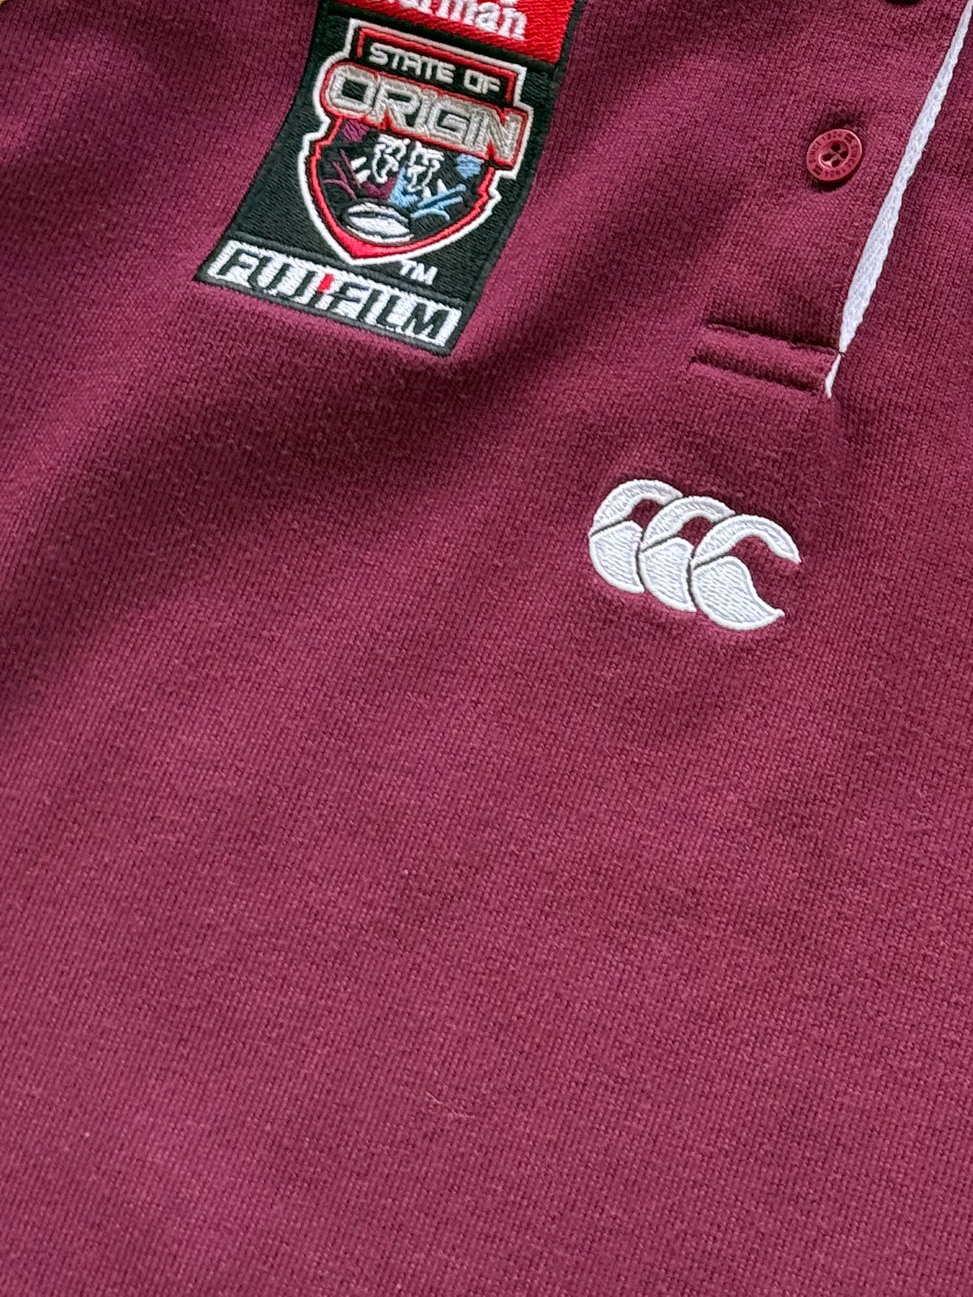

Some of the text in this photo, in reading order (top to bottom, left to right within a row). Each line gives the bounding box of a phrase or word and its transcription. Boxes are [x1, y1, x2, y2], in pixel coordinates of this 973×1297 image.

[369, 42, 501, 95] STATE OF
[325, 63, 524, 163] ORIGIN
[399, 259, 438, 286] TM
